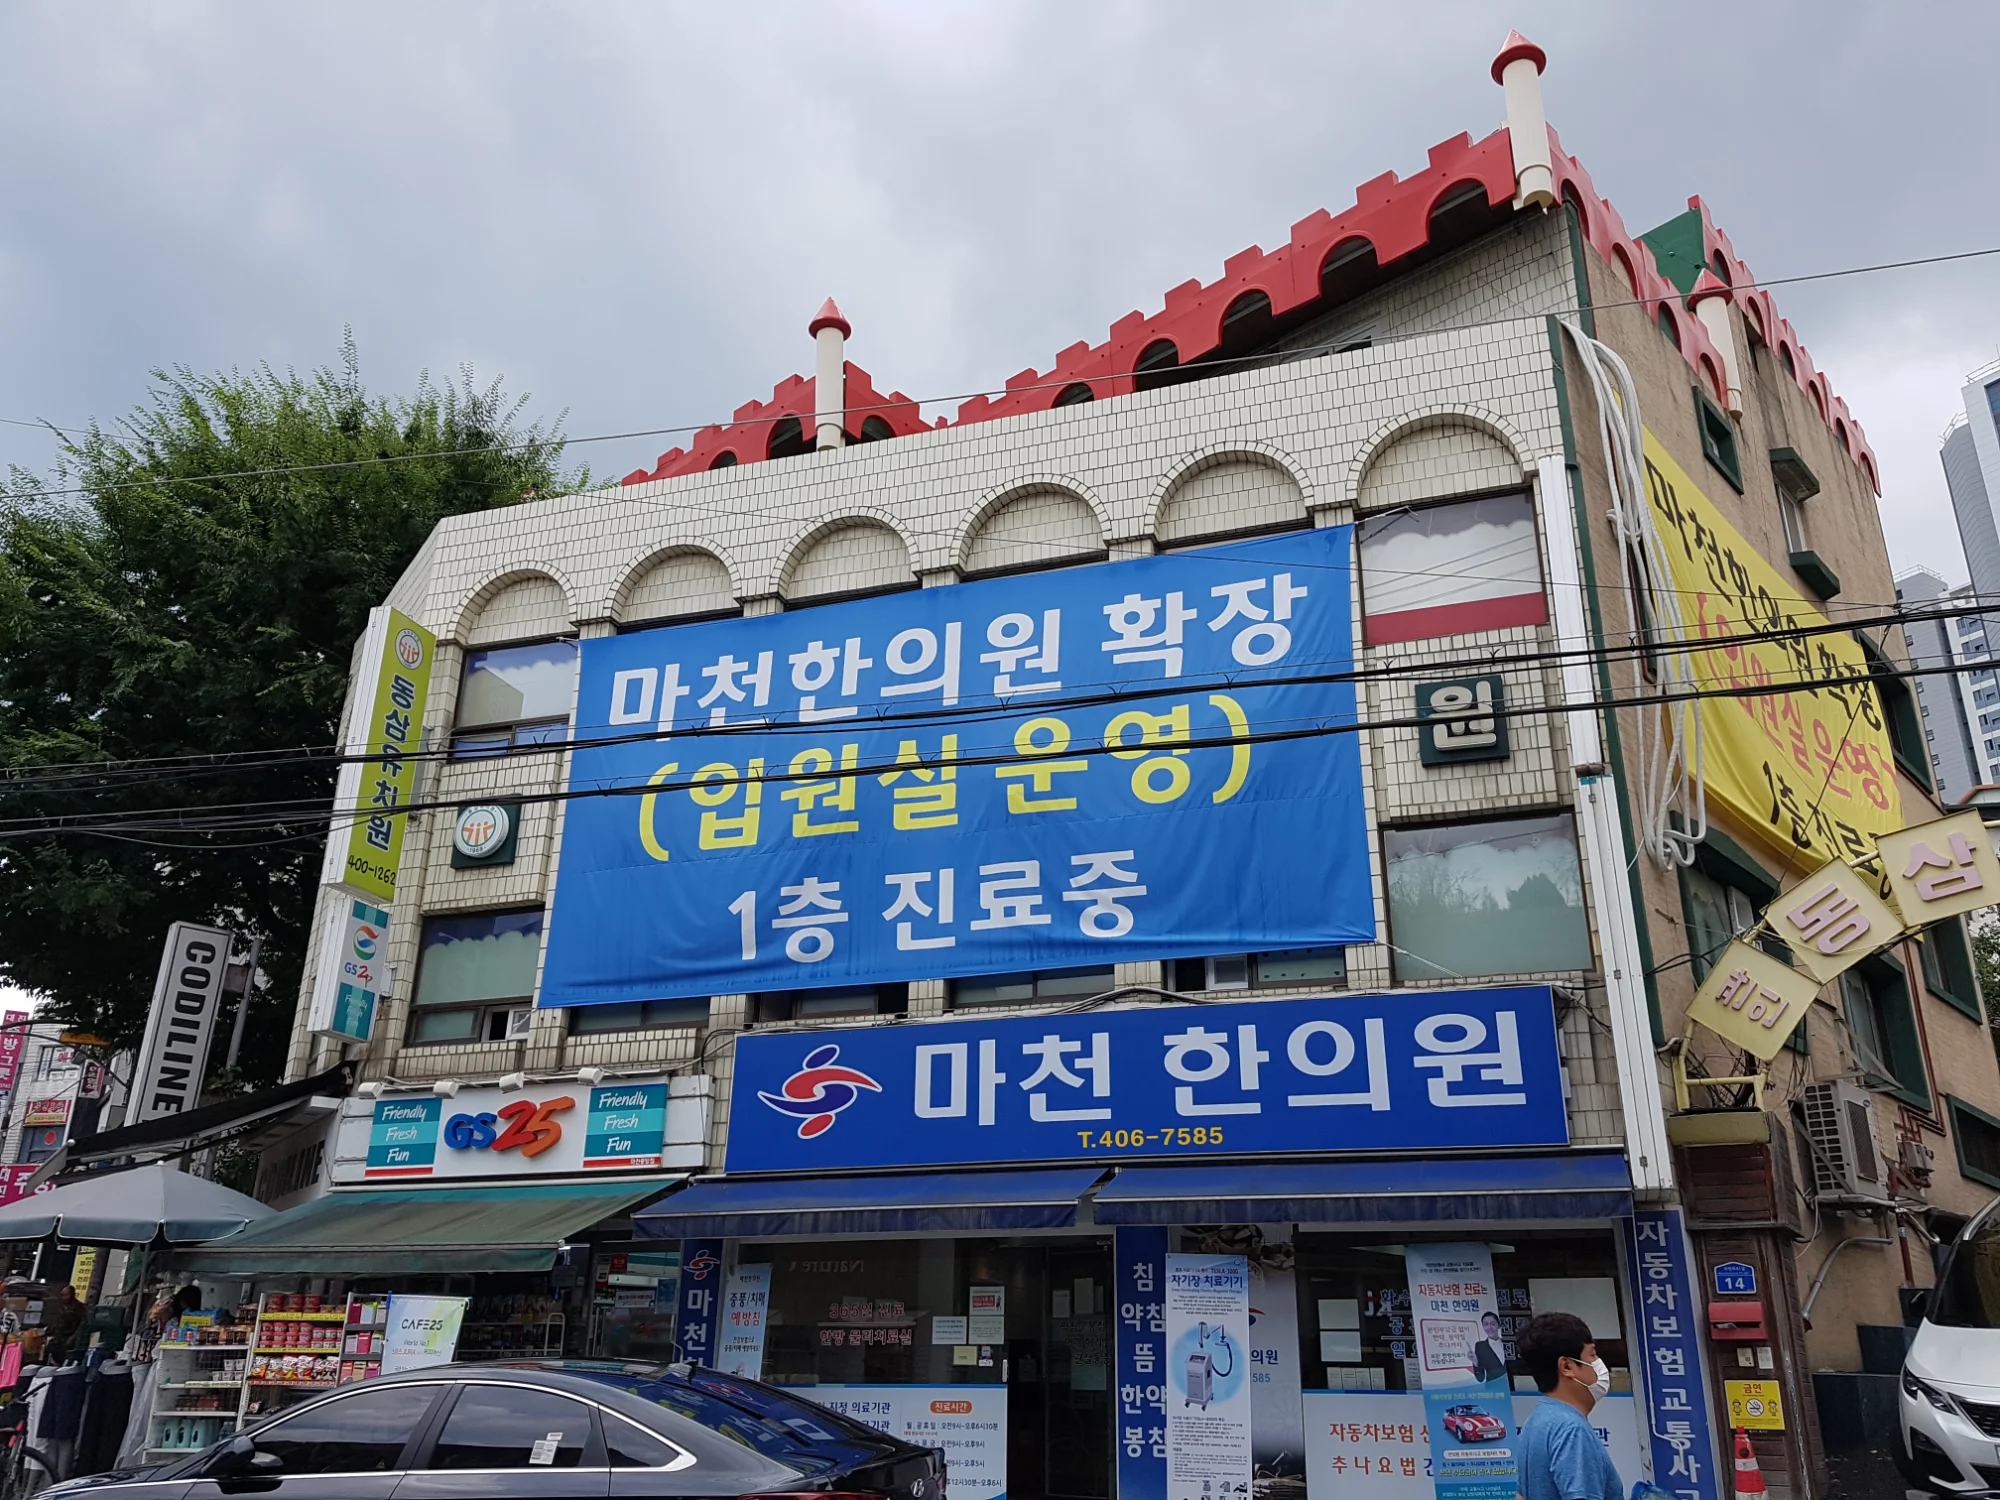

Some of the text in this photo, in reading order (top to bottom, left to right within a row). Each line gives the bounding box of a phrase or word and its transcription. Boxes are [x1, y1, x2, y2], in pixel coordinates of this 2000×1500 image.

[1643, 453, 1819, 699] 마천한의원
[609, 573, 1307, 741] 마천한의원 확장
[366, 673, 415, 852] 동삼유치원
[347, 854, 397, 886] 400-1262
[728, 849, 1147, 963] 1층 진료중
[914, 1011, 1526, 1126] 마천 한의원
[599, 1090, 648, 1110] Friendly
[382, 1105, 427, 1122] Friendly
[604, 1115, 639, 1130] Fresh
[386, 1127, 417, 1141] Fresh
[444, 1095, 576, 1158] GS25
[607, 1138, 631, 1152] Fun
[1077, 1126, 1224, 1149] T.406-7585
[387, 1148, 410, 1163] Fun
[1133, 1263, 1153, 1291] 침
[1171, 1275, 1243, 1288] 자기장 치료기기
[1725, 1278, 1745, 1289] 14
[1418, 1283, 1460, 1296] 자동차보험
[829, 1302, 905, 1319] 365일 진료
[1121, 1303, 1167, 1332] 약침
[401, 1319, 443, 1331] CAFE25
[683, 1289, 713, 1367] 마천
[820, 1329, 912, 1345] 한방 물리치료실
[1133, 1344, 1155, 1373] 뜸
[1252, 1373, 1271, 1383] 585
[1743, 1384, 1762, 1394] 금연
[851, 1402, 891, 1414] 의료기관
[935, 1403, 968, 1413] 진료시간
[1121, 1384, 1167, 1415] 한약
[1123, 1427, 1167, 1458] 봉침
[1329, 1422, 1414, 1444] 자동차보험
